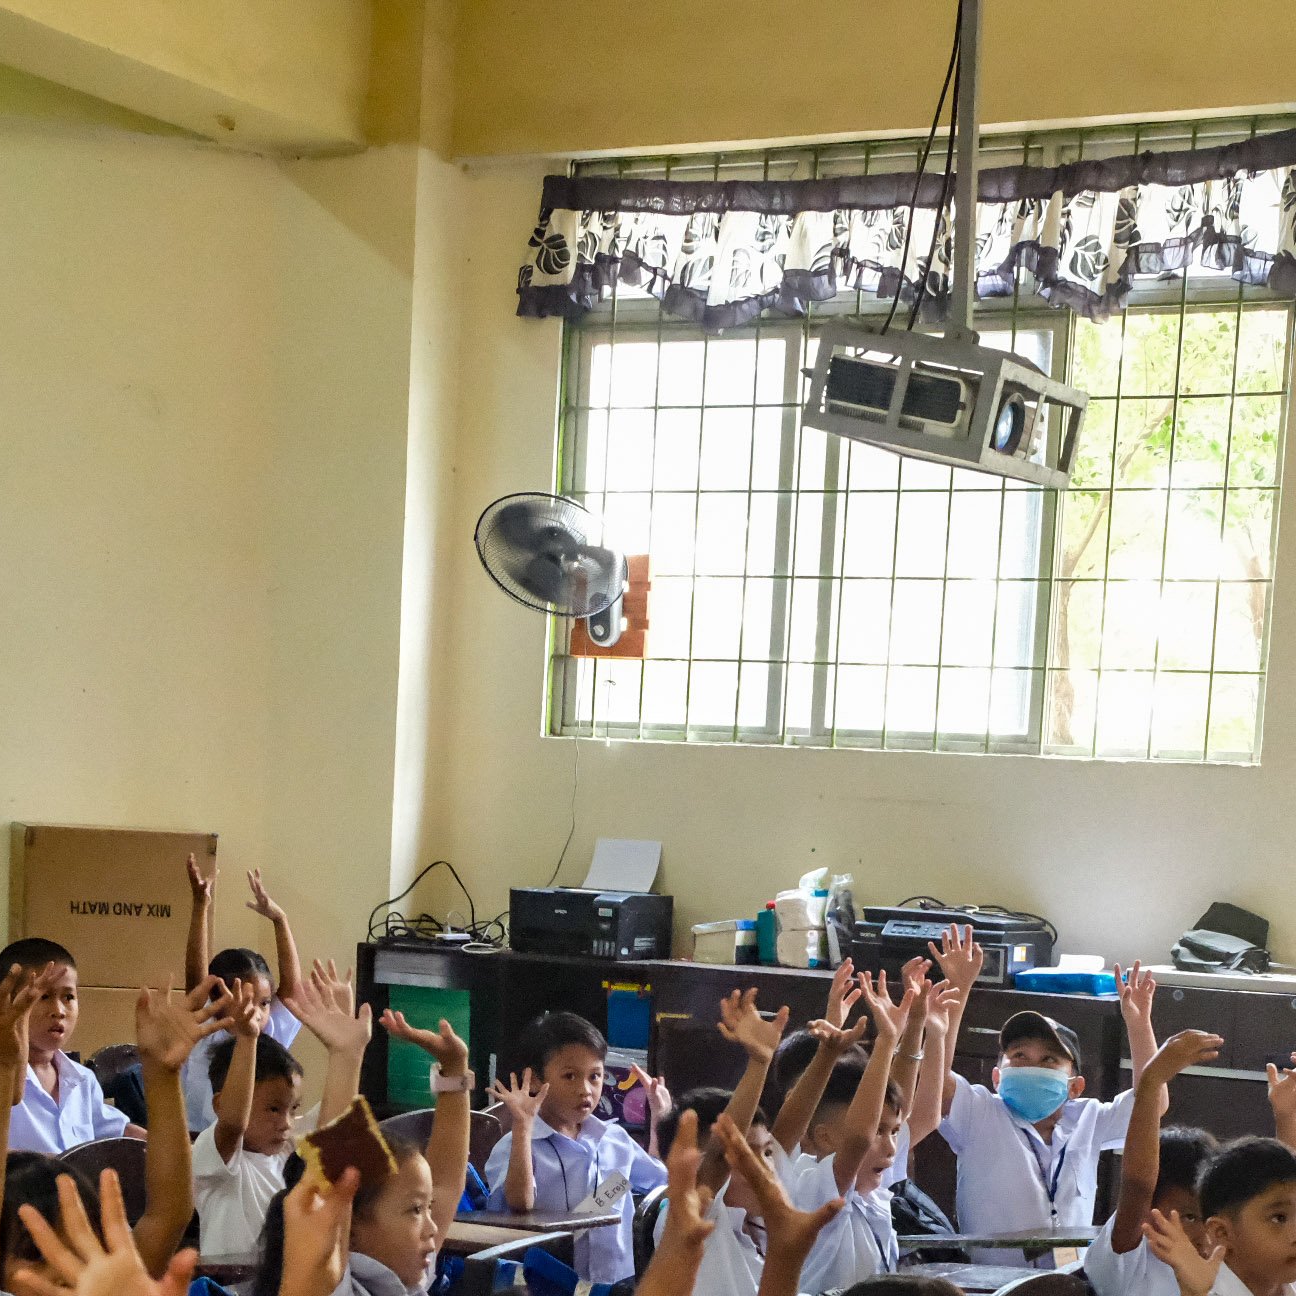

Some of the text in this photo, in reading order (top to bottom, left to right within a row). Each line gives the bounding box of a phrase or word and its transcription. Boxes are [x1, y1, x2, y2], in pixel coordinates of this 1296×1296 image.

[69, 900, 171, 918] MIX AND MATH
